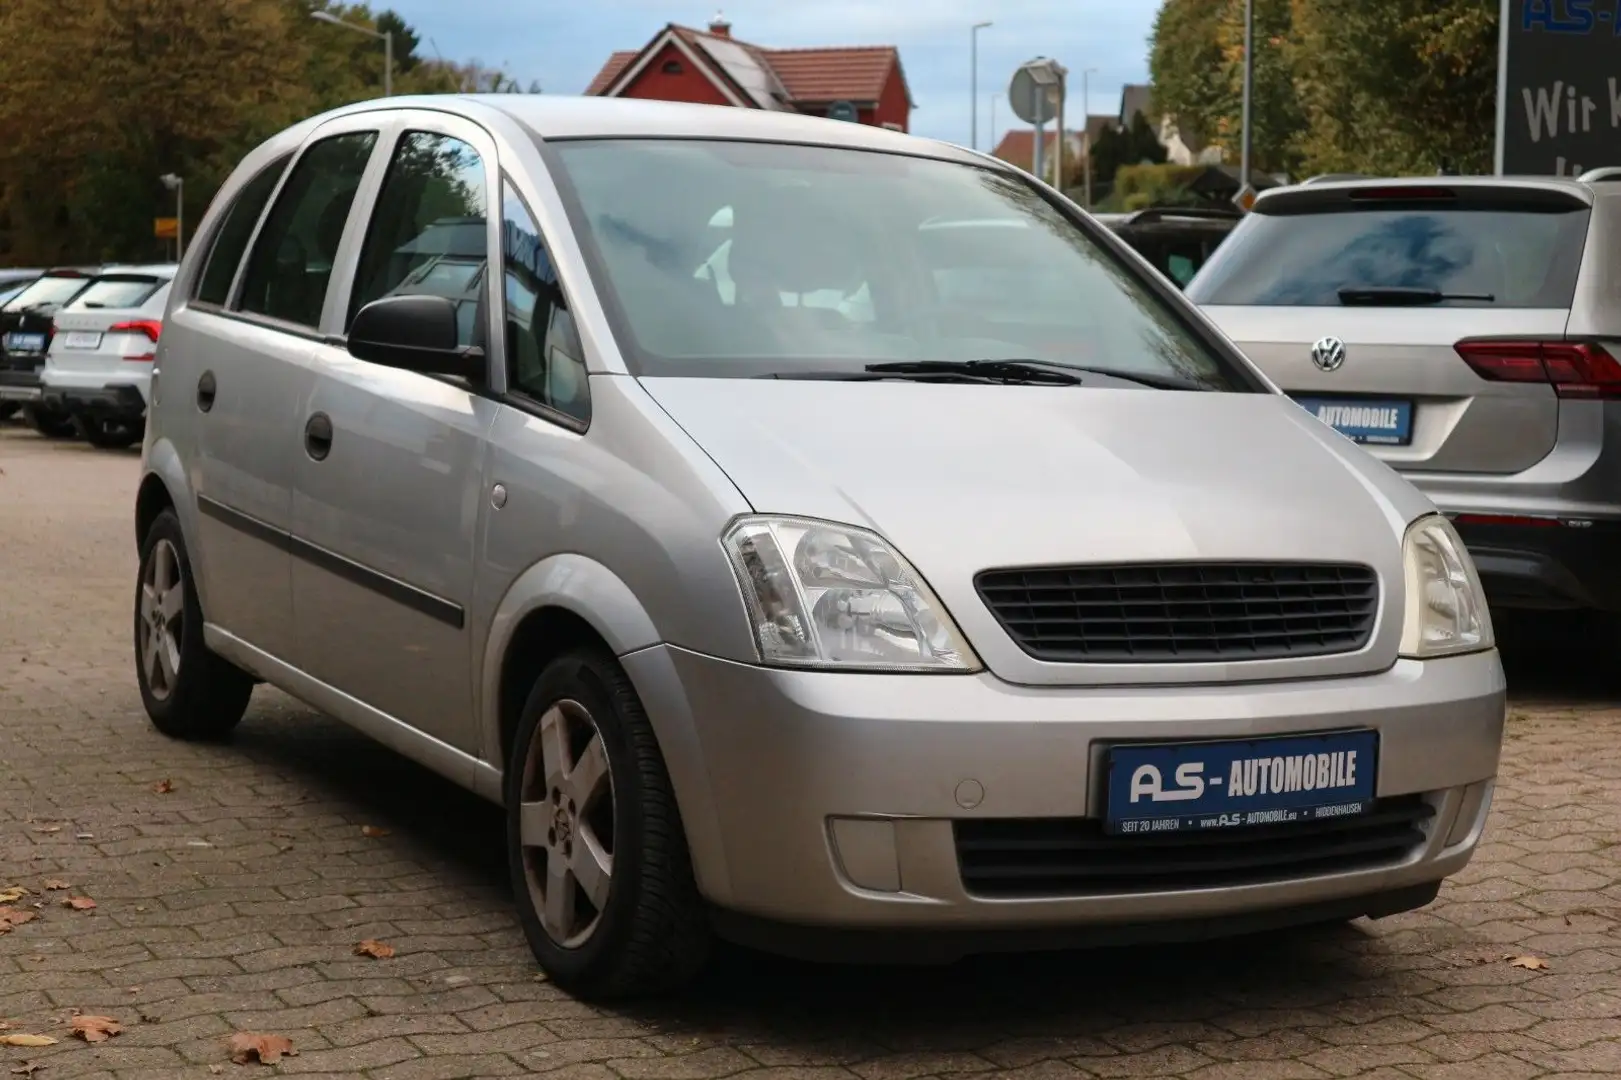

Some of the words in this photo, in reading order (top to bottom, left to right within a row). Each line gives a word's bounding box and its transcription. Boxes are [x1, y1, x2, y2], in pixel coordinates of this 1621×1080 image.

[1522, 80, 1597, 143] Wir
[1122, 820, 1139, 833] SEIT
[1139, 820, 1150, 832] 20
[1151, 818, 1180, 831] JAHREN
[1315, 802, 1362, 818] HIDDENHAUSEN
